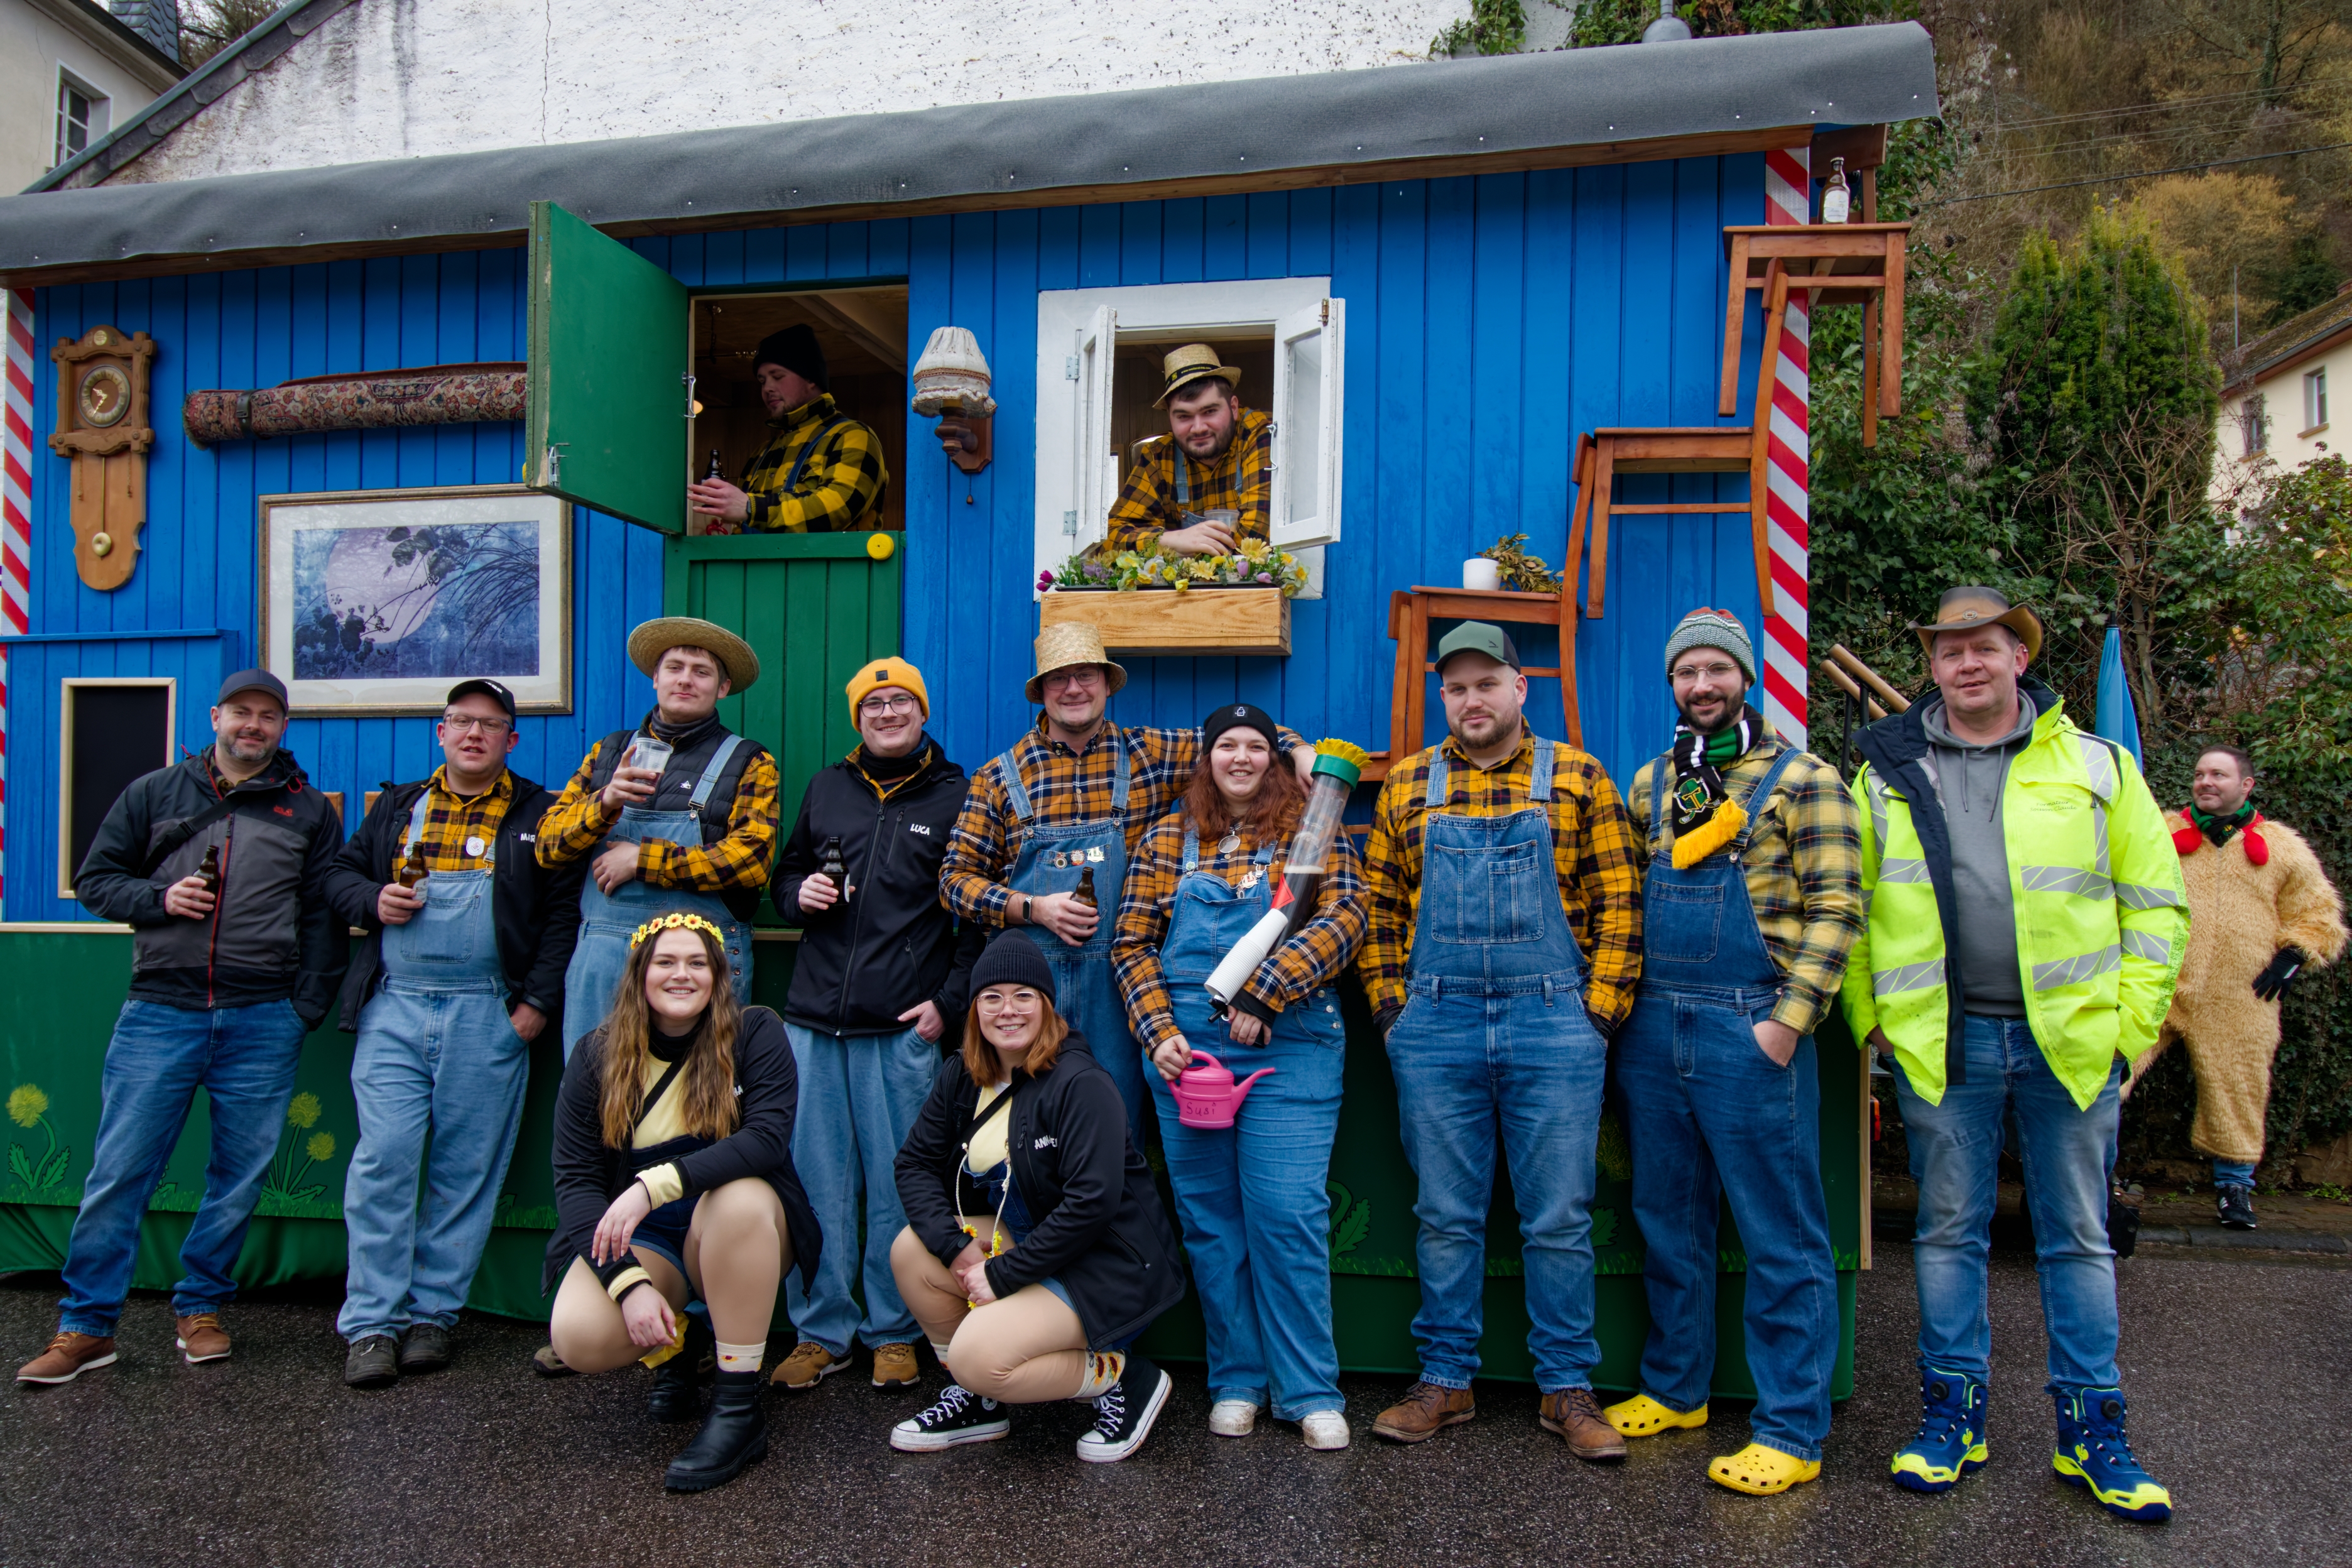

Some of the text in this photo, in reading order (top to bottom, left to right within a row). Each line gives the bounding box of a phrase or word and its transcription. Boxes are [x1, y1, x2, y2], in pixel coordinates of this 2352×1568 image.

[910, 823, 930, 836] LUCA
[520, 832, 536, 843] MAR
[1186, 1101, 1217, 1116] Susi
